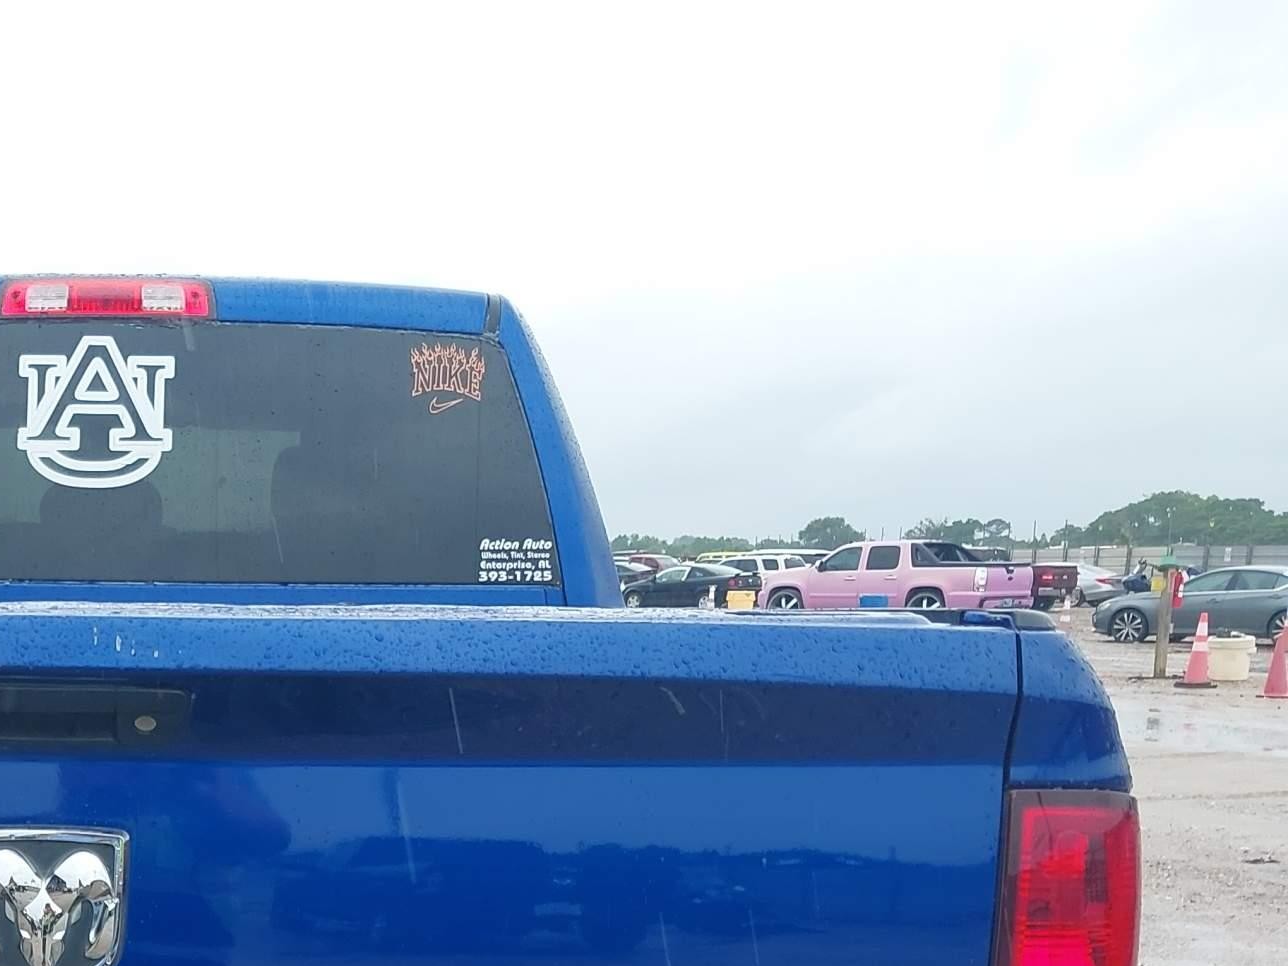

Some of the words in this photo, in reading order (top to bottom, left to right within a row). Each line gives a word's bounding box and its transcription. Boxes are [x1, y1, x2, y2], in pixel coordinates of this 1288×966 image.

[410, 350, 485, 402] NIKE
[479, 538, 520, 550] Action
[522, 538, 553, 550] Auto
[481, 551, 509, 560] Wheels,
[510, 551, 526, 560] Tint,
[526, 551, 551, 559] Stereo
[480, 560, 536, 571] Enterprise,
[538, 560, 552, 569] AL
[478, 570, 553, 582] 393-1725
